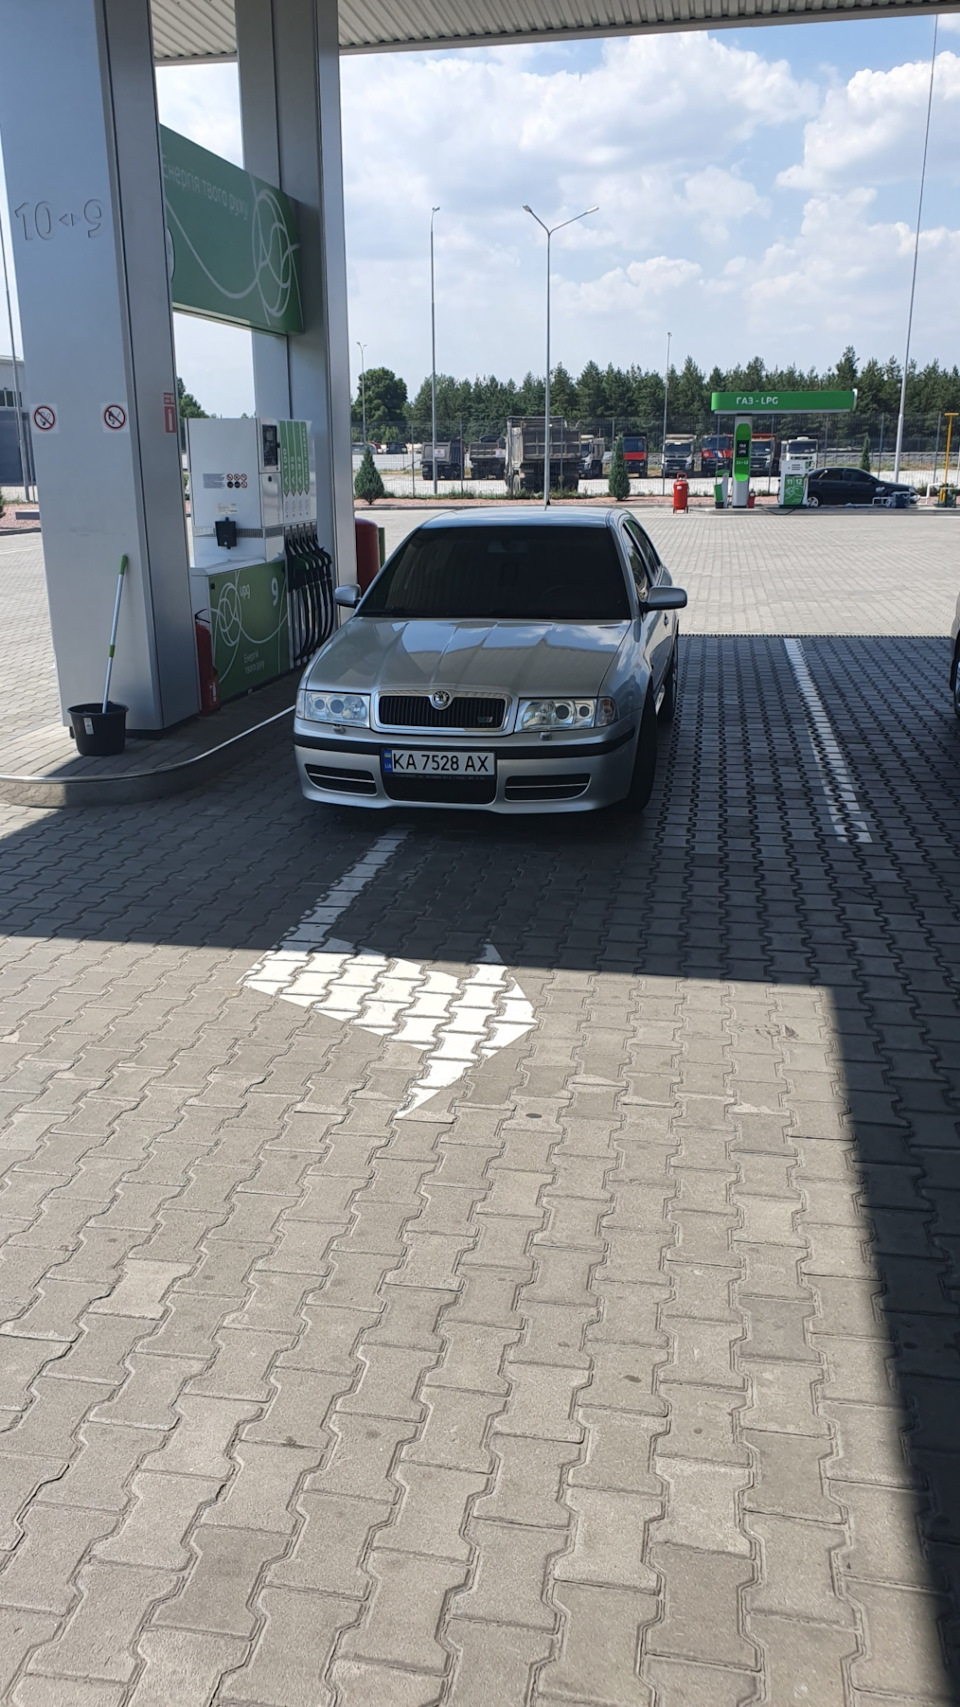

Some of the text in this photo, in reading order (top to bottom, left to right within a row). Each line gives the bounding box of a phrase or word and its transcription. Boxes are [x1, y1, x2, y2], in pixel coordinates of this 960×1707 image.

[201, 179, 228, 207] твого
[229, 193, 249, 221] руху
[15, 201, 53, 240] 10
[84, 199, 102, 238] 9
[736, 396, 754, 405] ГАЗ
[761, 396, 779, 405] LPG
[271, 577, 279, 607] 9
[393, 753, 489, 772] KA 7528 AX
